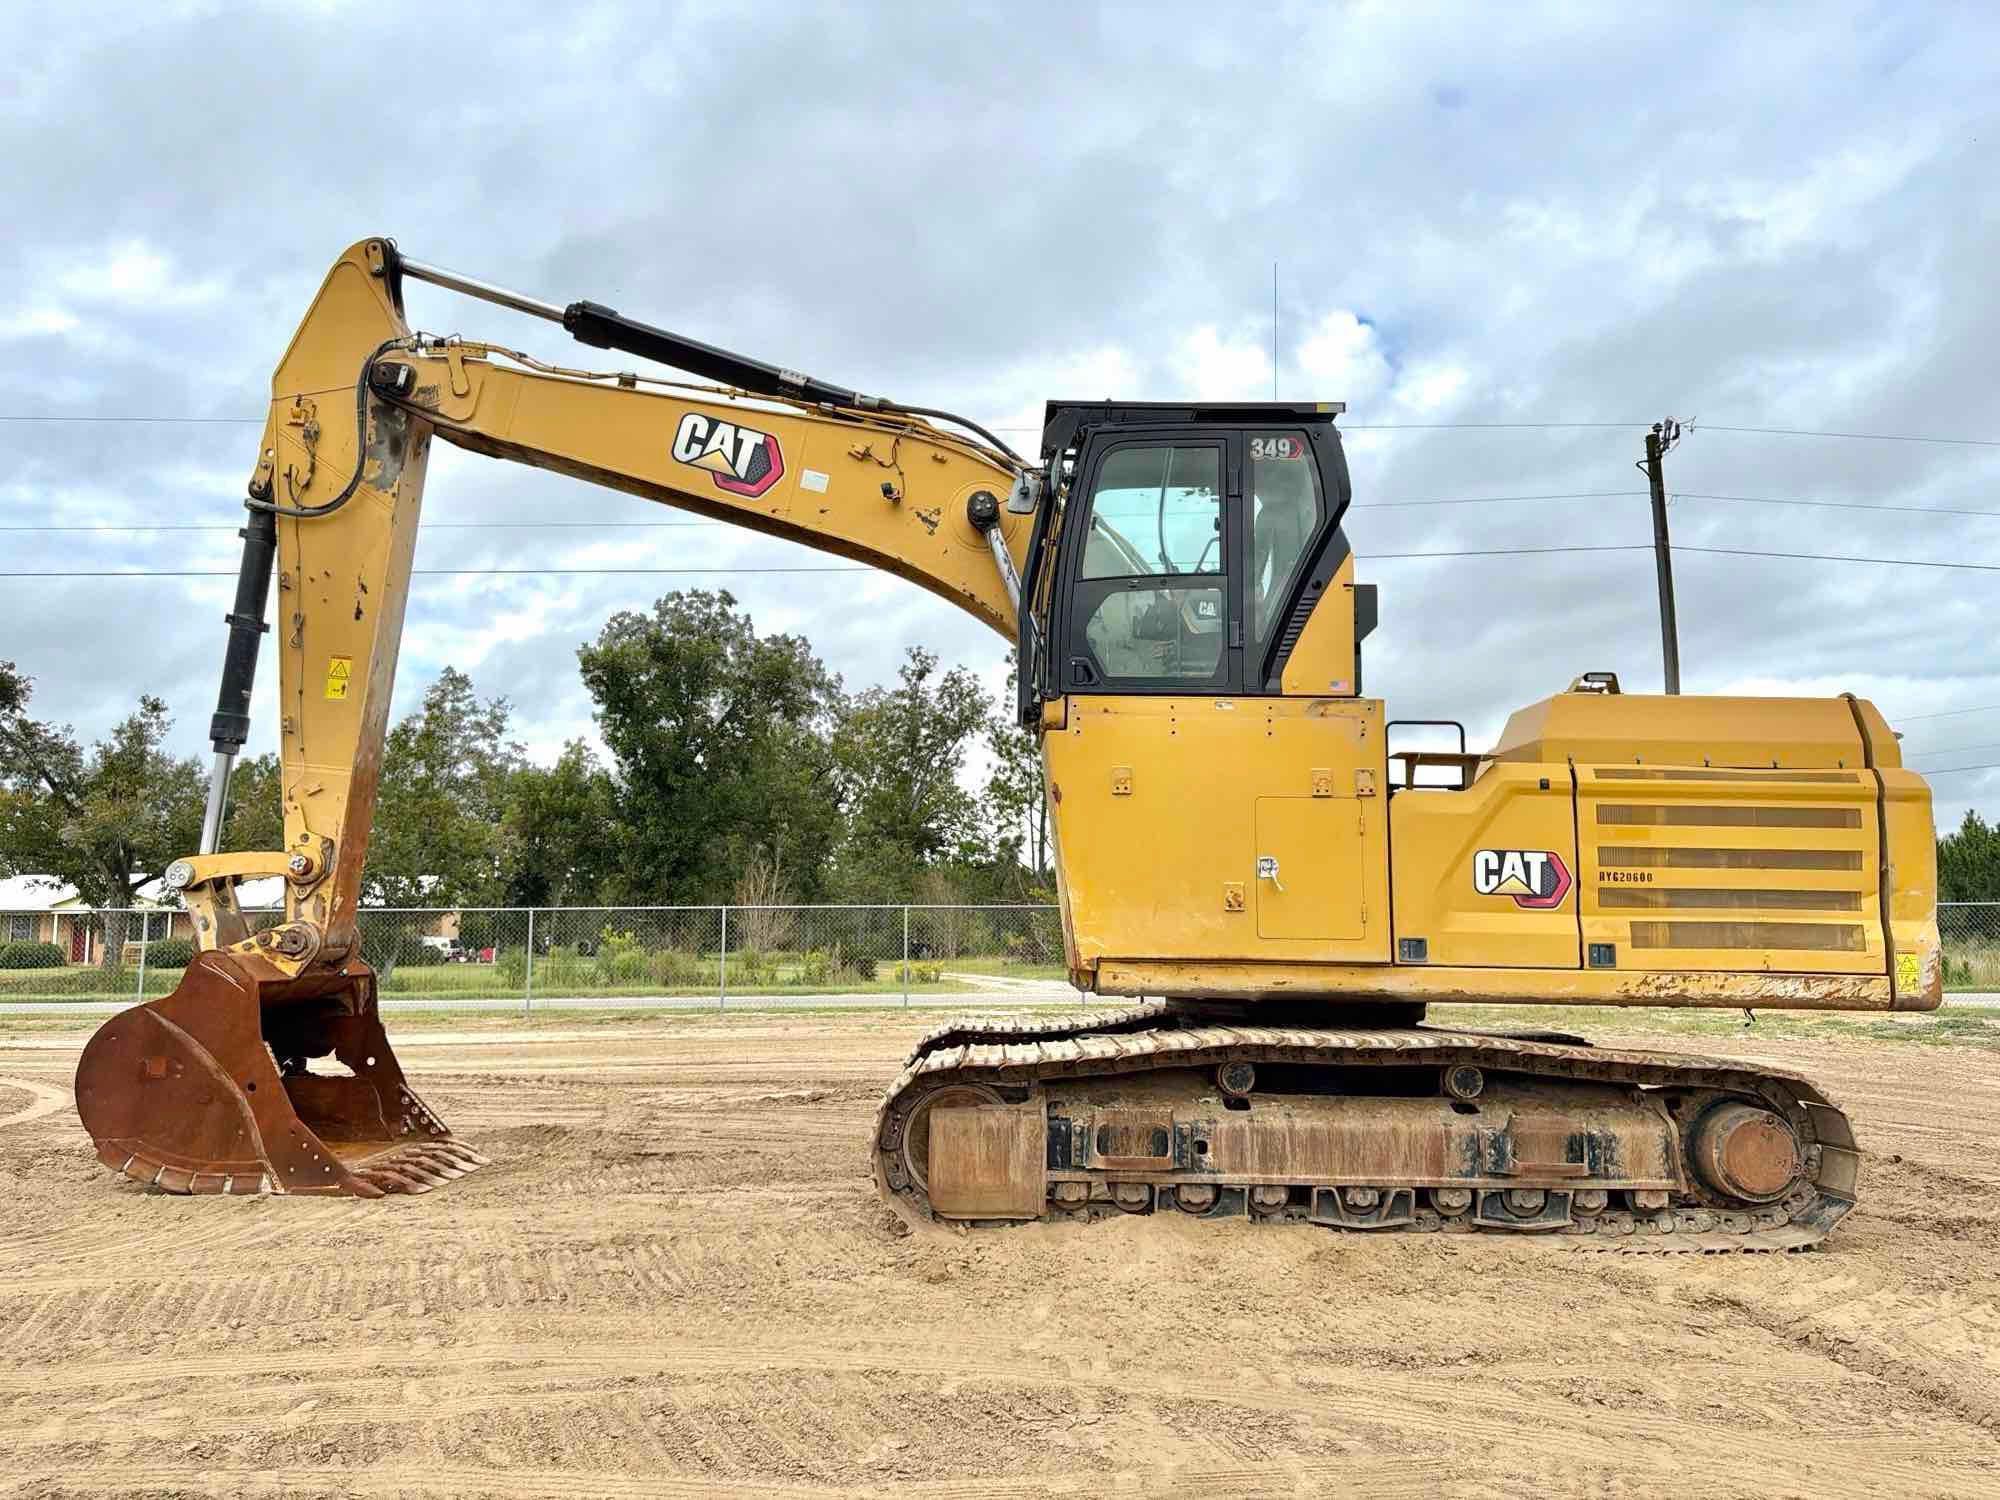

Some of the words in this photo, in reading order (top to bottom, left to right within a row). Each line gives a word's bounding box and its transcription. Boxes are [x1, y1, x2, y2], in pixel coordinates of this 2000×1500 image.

[674, 413, 766, 479] CAT
[1250, 438, 1291, 458] 349
[1199, 600, 1217, 617] CA
[1475, 850, 1548, 895] CAT
